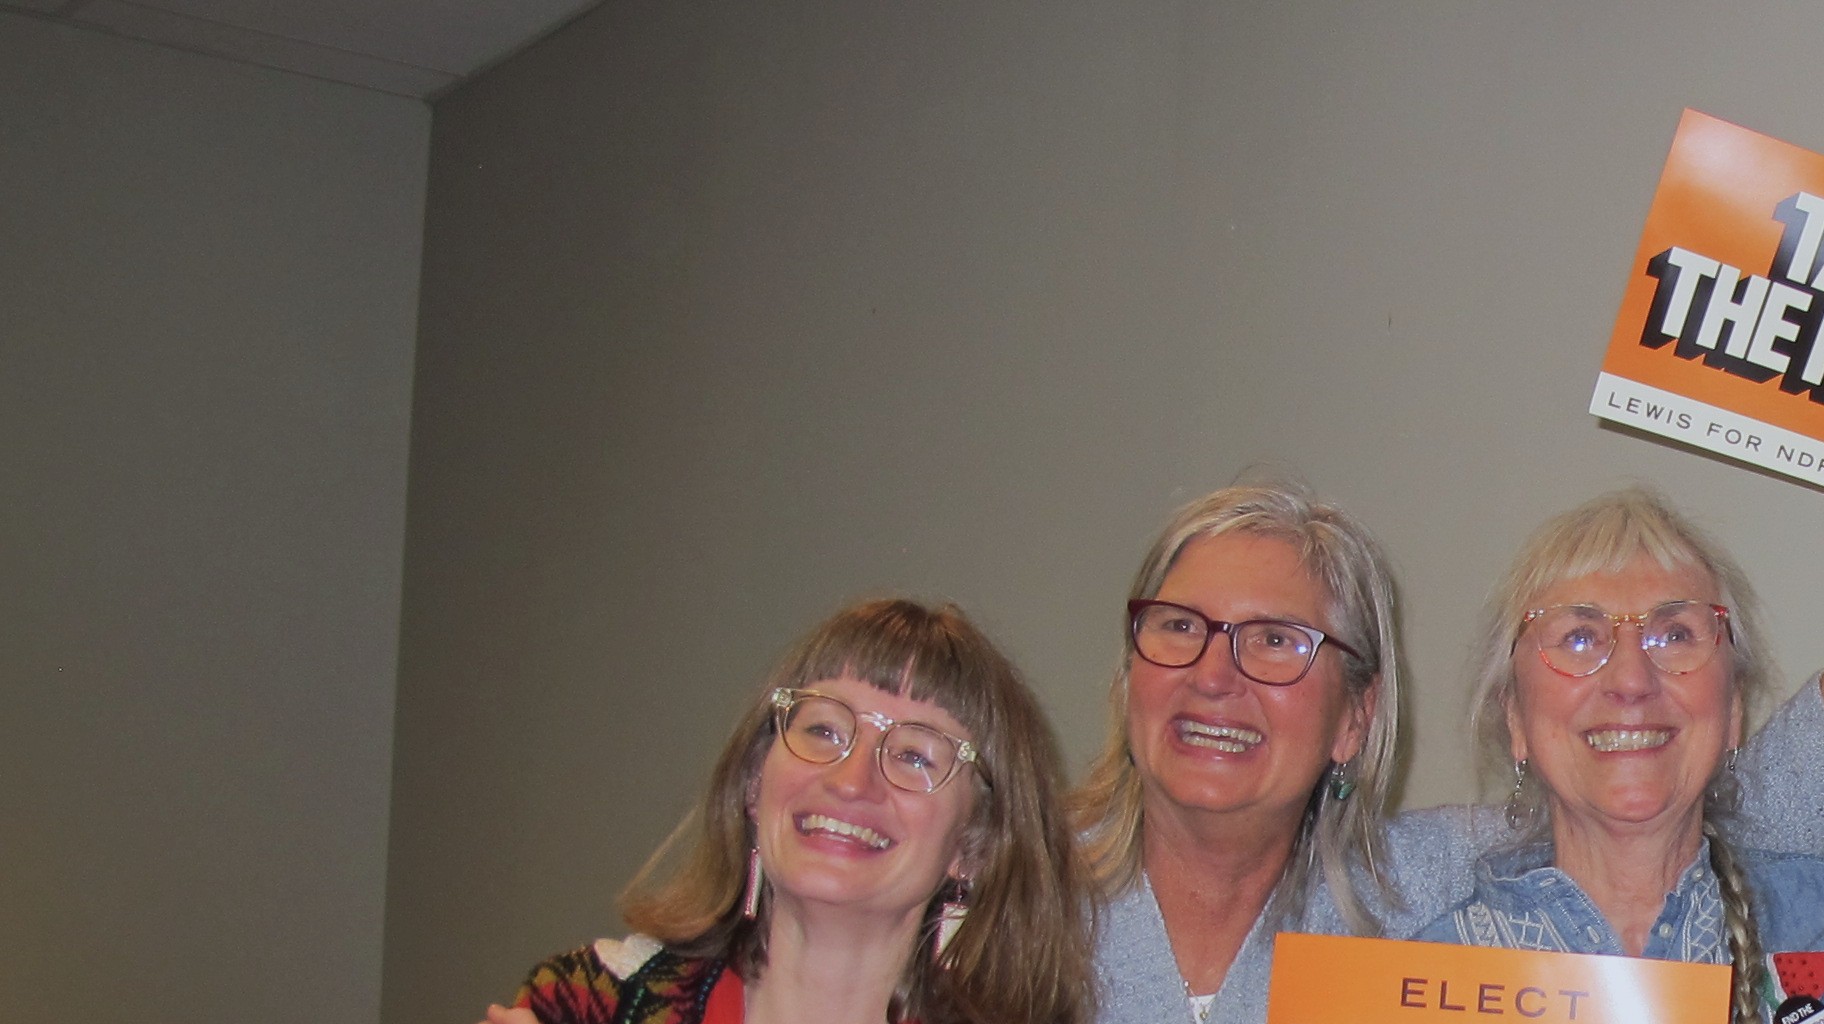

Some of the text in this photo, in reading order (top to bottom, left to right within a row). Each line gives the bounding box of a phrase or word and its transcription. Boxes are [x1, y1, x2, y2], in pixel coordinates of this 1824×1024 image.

[1660, 246, 1813, 375] THE
[1608, 391, 1693, 431] LEWIS
[1706, 422, 1763, 453] FOR
[1400, 977, 1591, 1021] ELECT
[1797, 1003, 1815, 1019] THE
